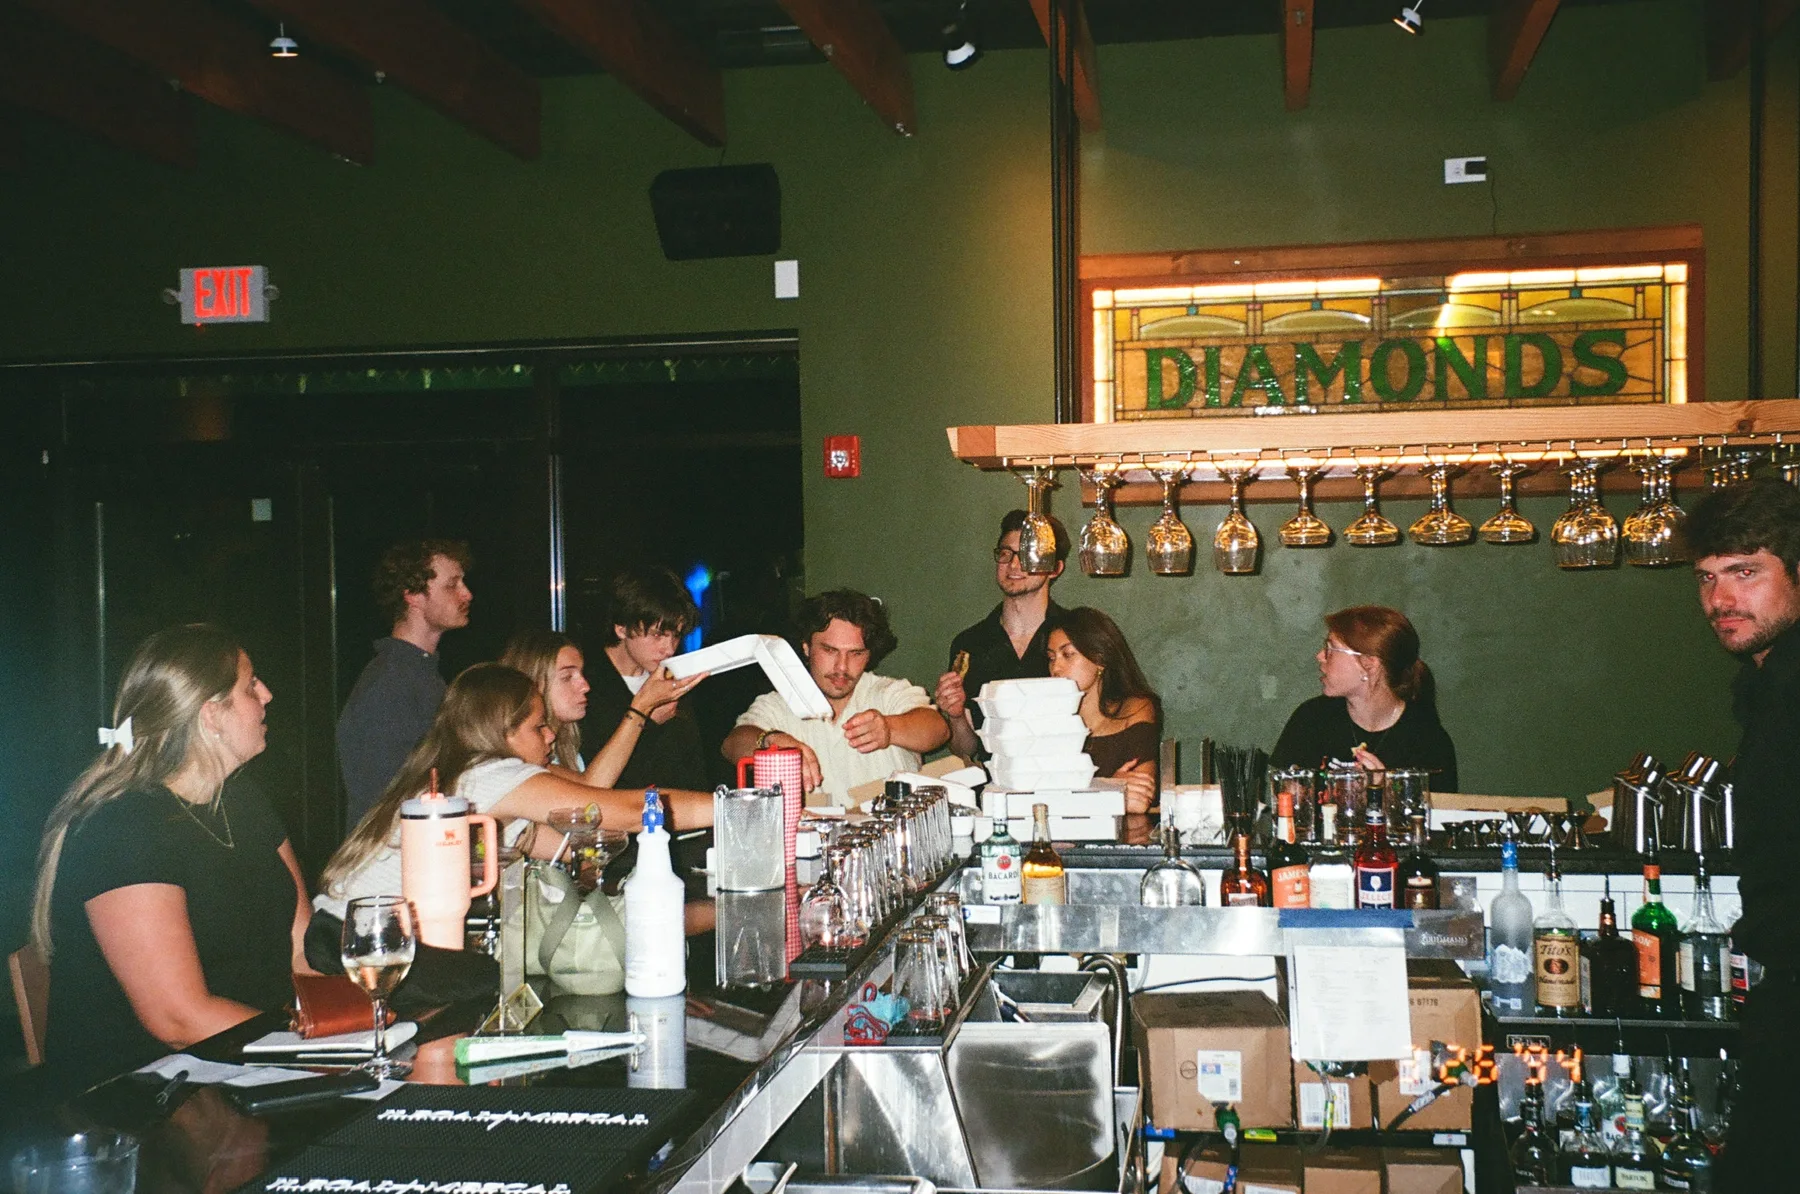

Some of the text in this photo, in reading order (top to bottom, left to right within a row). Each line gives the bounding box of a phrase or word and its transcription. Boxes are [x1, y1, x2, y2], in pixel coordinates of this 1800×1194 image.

[194, 267, 253, 318] EXIT
[1145, 328, 1628, 410] DIAMONDS
[988, 871, 1019, 880] BACARD
